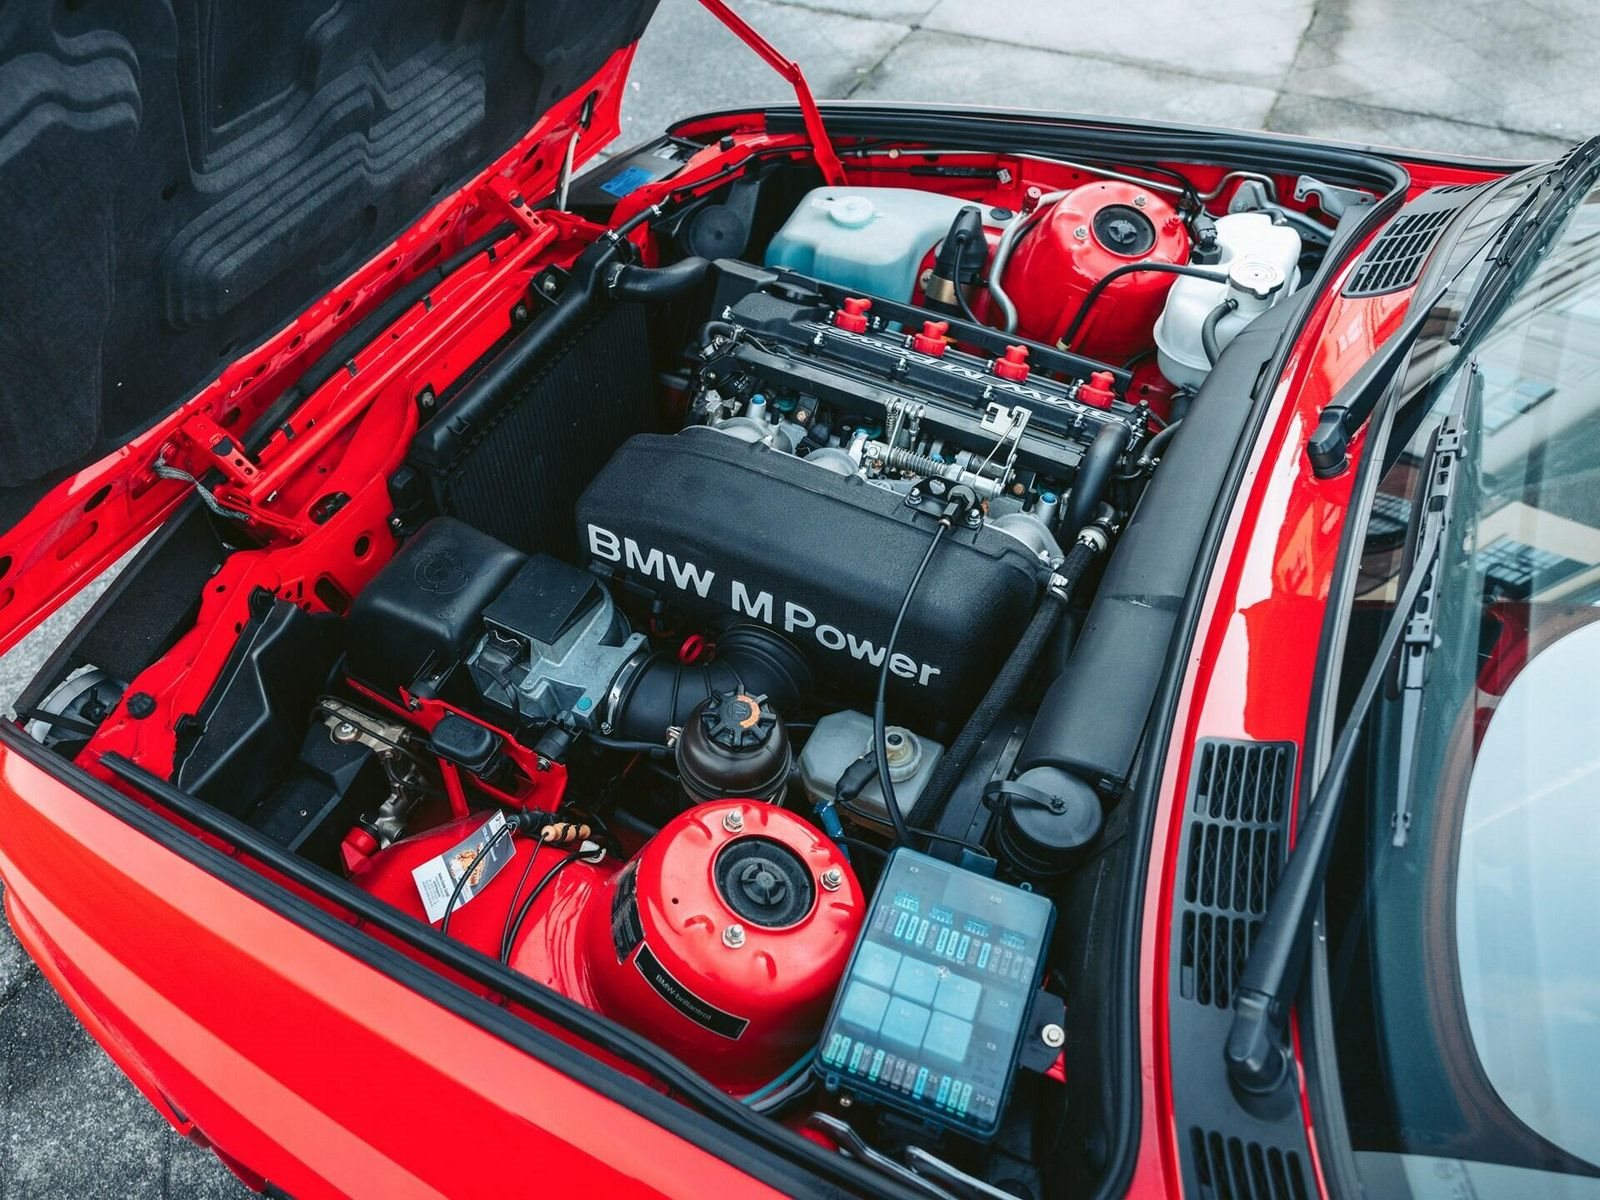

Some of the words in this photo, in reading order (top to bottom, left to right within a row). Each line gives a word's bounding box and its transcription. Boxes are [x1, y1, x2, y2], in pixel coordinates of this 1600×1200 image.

[587, 523, 715, 598] BMW
[731, 580, 774, 625] M
[784, 601, 942, 687] Power
